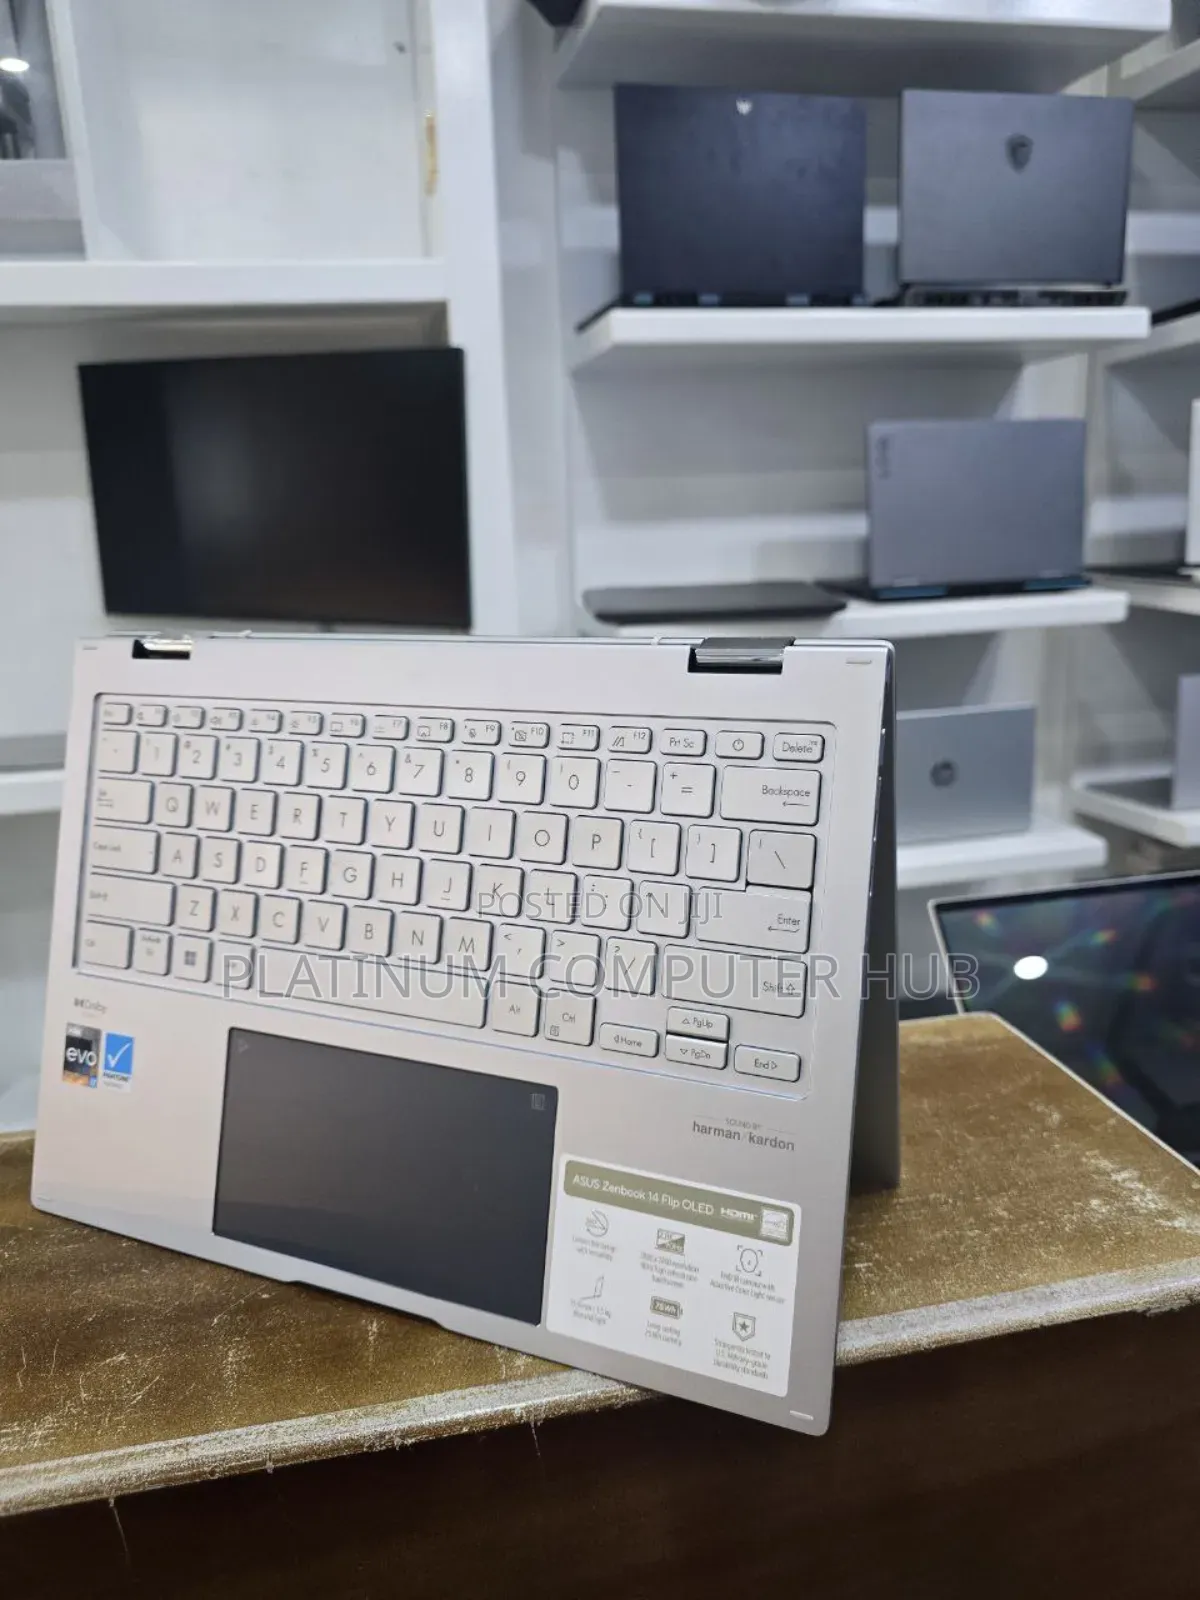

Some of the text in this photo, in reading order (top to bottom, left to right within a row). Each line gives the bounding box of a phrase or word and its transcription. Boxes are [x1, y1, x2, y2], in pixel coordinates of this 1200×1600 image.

[440, 722, 448, 731] F8
[486, 724, 496, 733] F9
[530, 726, 544, 736] F10
[582, 728, 596, 738] F11
[633, 731, 646, 740] F12
[683, 739, 695, 749] Sc
[782, 742, 813, 754] Delete
[192, 750, 202, 764] 2
[232, 752, 242, 766] 3
[276, 756, 286, 770] 4
[320, 757, 330, 773] 5
[366, 762, 377, 776] 6
[412, 764, 425, 779] 7
[464, 766, 474, 783] 8
[515, 770, 526, 786] 9
[568, 774, 580, 790] 0
[761, 784, 811, 798] Backspace
[166, 796, 180, 814] Q
[205, 801, 220, 816] W
[250, 804, 259, 820] E
[292, 808, 302, 824] R
[339, 812, 348, 828] T
[384, 815, 396, 832] Y
[432, 820, 446, 837] U
[534, 829, 550, 847] O
[591, 834, 602, 850] P
[172, 849, 182, 864] A
[213, 852, 224, 868] S
[255, 856, 266, 873] D
[300, 862, 309, 877] F
[342, 866, 358, 884] G
[391, 872, 404, 888] H
[443, 877, 452, 894] J
[492, 882, 503, 899] K
[190, 900, 200, 916] Z
[230, 905, 240, 922] X
[272, 911, 286, 928] C
[317, 916, 330, 932] V
[777, 913, 801, 926] Enter
[364, 923, 374, 940] B
[411, 930, 424, 946] N
[458, 936, 476, 954] M
[692, 1017, 714, 1030] PgUp
[620, 1036, 643, 1049] Home
[66, 1046, 98, 1066] evo
[690, 1048, 712, 1060] PgDn
[754, 1059, 769, 1070] End
[693, 1120, 795, 1152] harman kardon
[572, 1174, 715, 1216] ASUS Zenbook 14 Flip OLED
